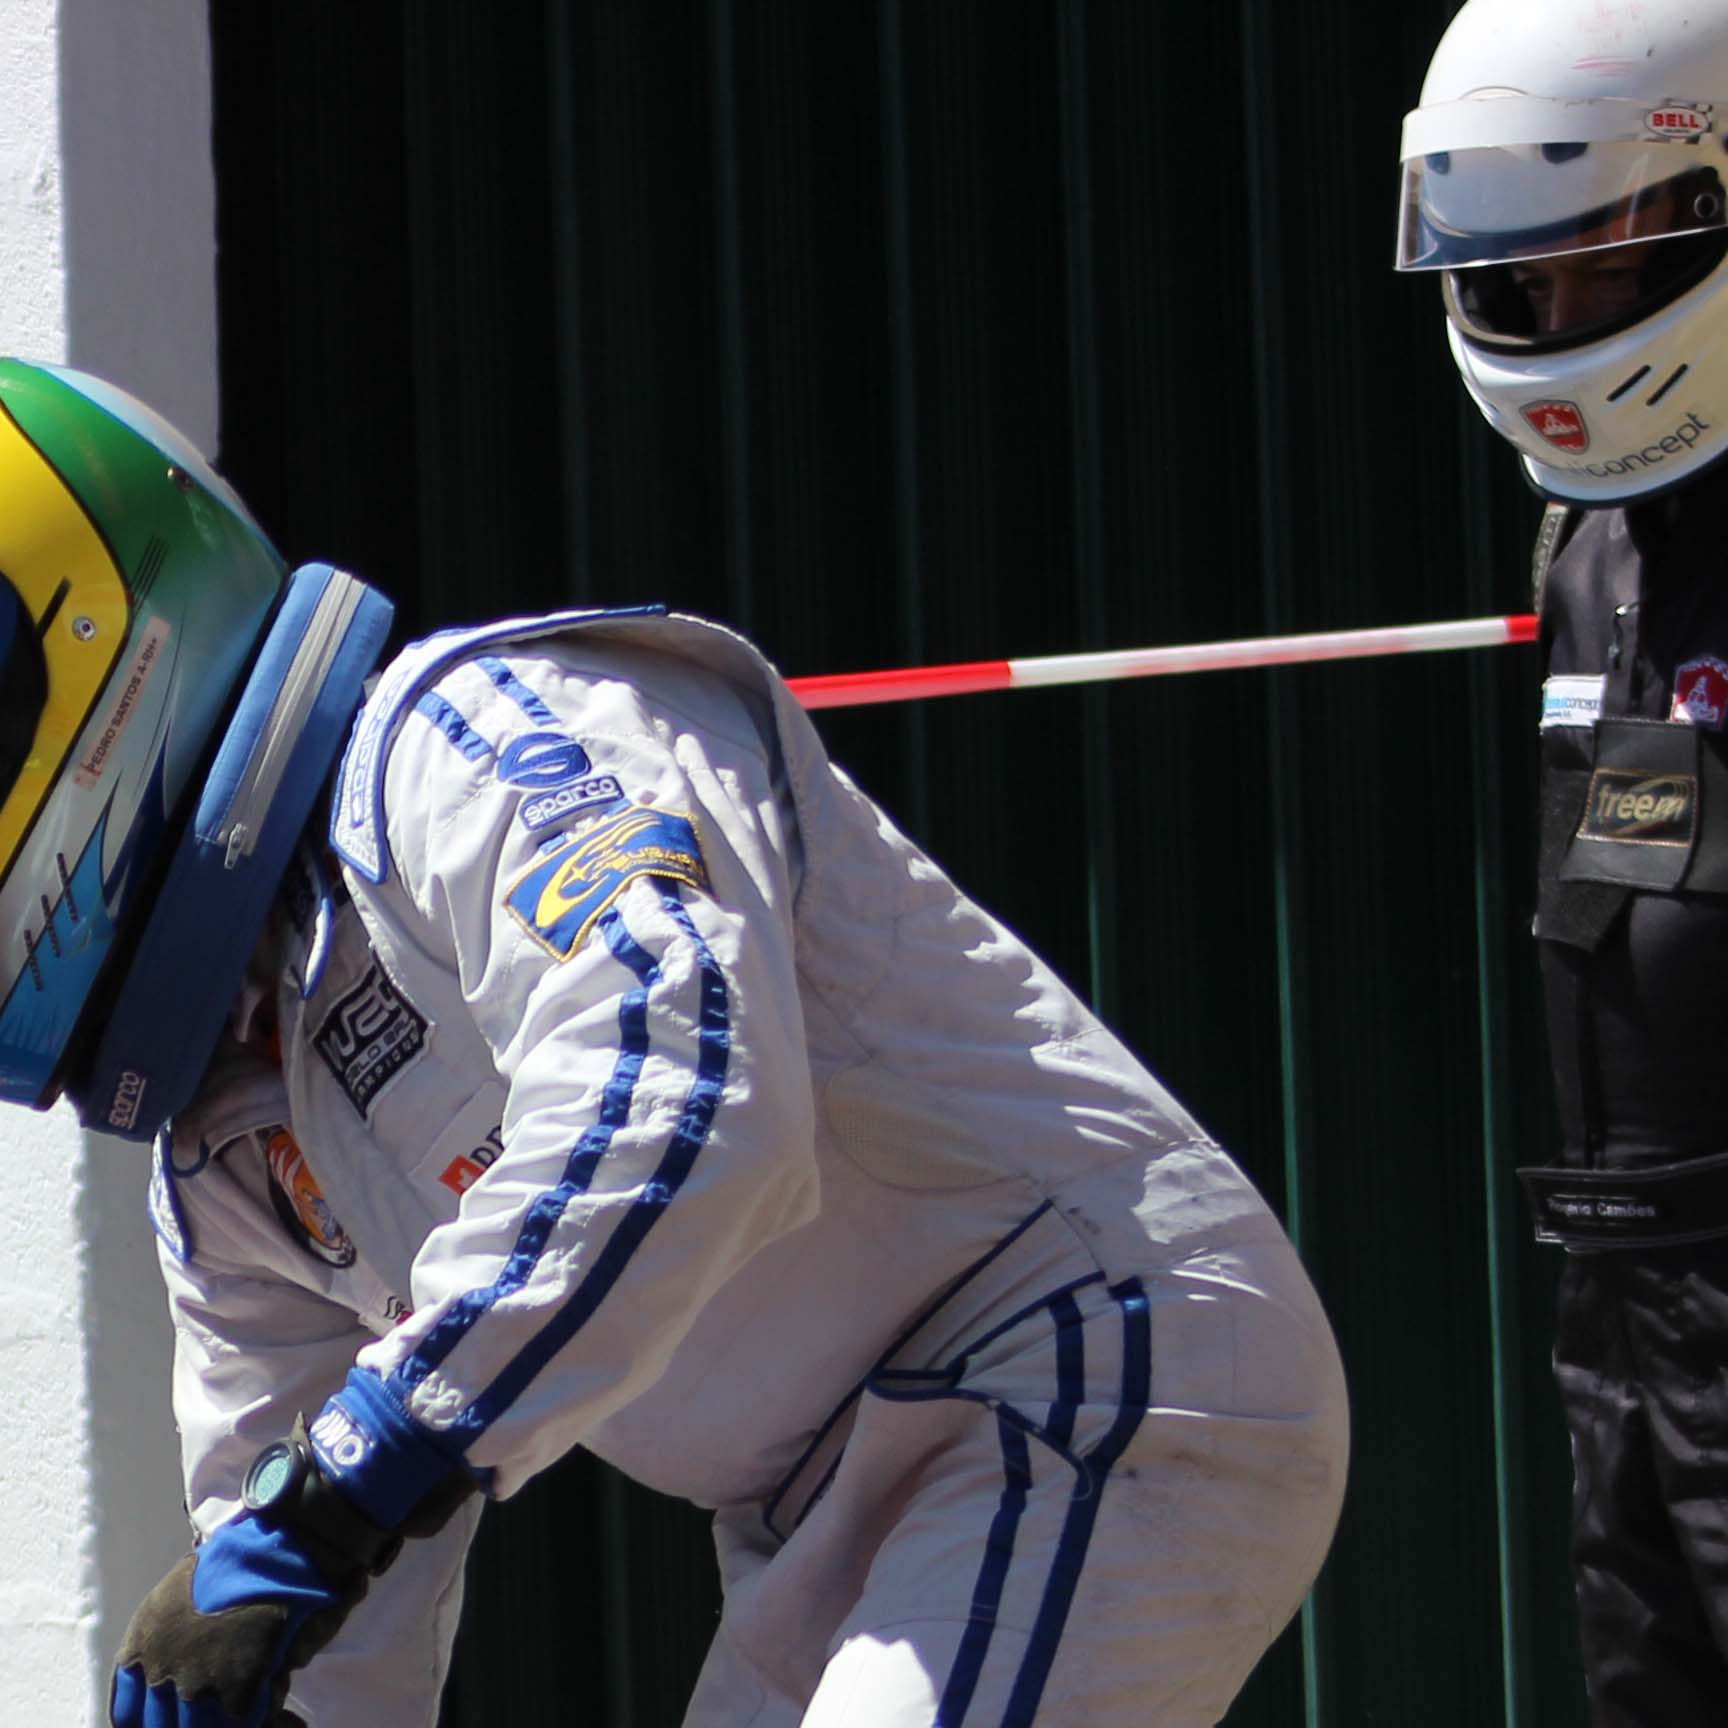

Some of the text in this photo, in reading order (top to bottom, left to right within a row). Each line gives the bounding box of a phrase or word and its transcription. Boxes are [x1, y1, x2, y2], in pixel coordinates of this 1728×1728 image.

[1652, 112, 1703, 129] BELL
[86, 727, 118, 773] PEDRO
[111, 675, 143, 730] SANTOS
[523, 776, 621, 827] sparco
